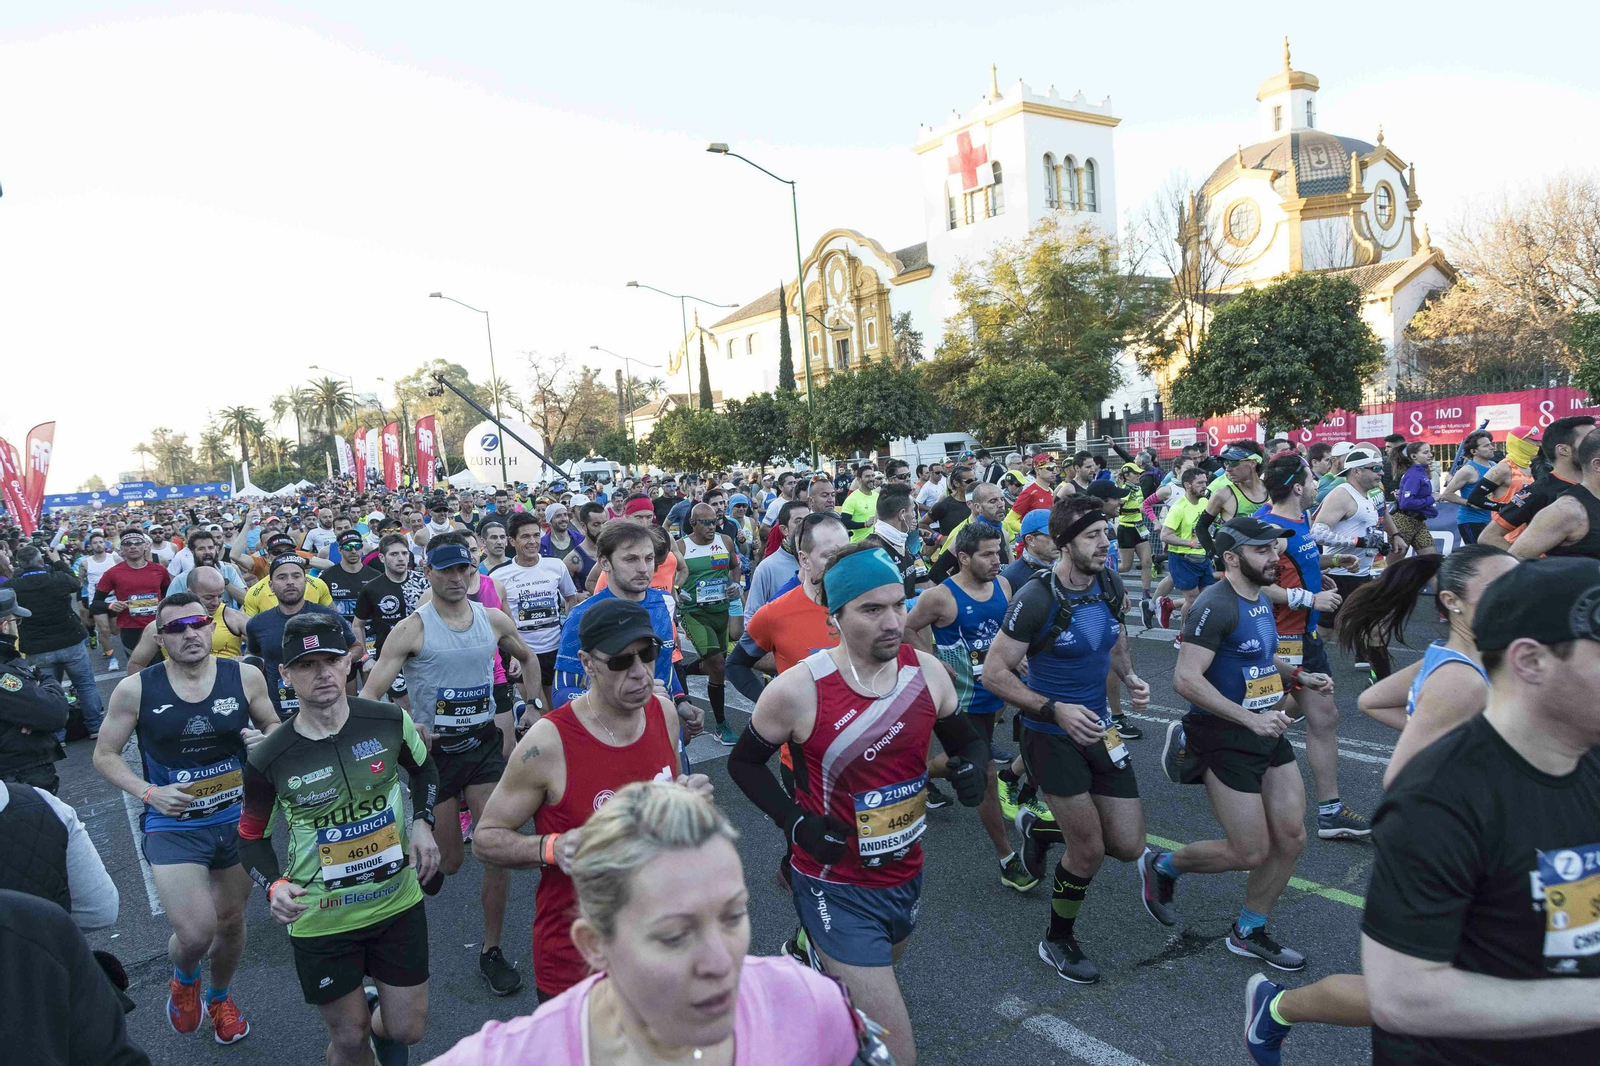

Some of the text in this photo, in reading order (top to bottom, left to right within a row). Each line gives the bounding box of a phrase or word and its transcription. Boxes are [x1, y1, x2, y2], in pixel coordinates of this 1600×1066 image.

[1435, 407, 1463, 419] IMD
[1322, 417, 1345, 428] MD
[1227, 424, 1247, 434] IMD
[470, 456, 518, 466] ZURICH
[1277, 647, 1291, 655] 620
[457, 688, 486, 698] ZURICH
[1259, 684, 1274, 695] 3414
[454, 706, 477, 715] 2762
[455, 717, 472, 725] RAÚL
[194, 762, 232, 779] ZURICH
[196, 784, 223, 797] 3722
[187, 789, 239, 809] ABLO JIMÉNEZ
[345, 816, 387, 837] ZURICH
[348, 842, 379, 859] 4610
[345, 856, 383, 874] ENRIQUE
